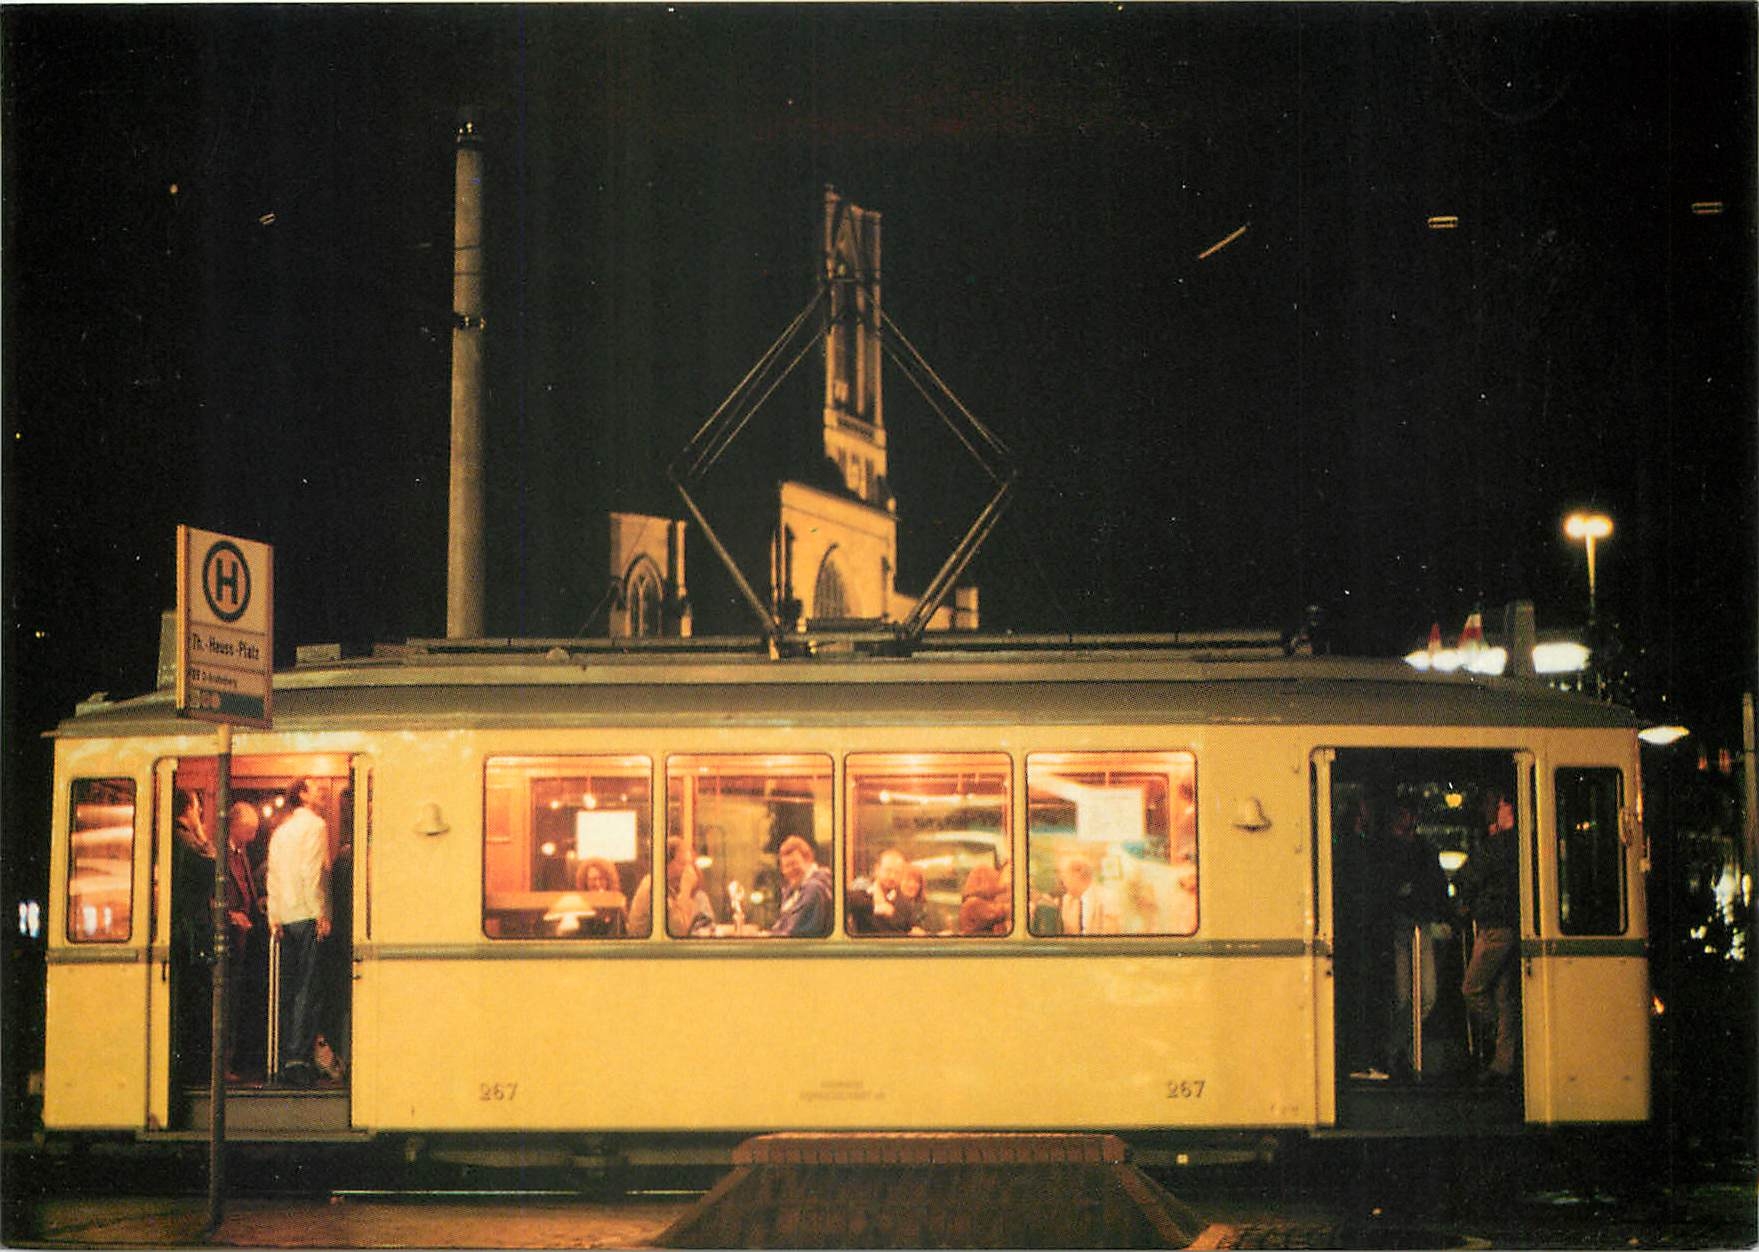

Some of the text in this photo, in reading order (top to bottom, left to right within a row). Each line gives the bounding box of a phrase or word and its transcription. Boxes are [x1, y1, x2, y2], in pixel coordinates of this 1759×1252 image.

[216, 559, 238, 605] H
[480, 1082, 518, 1102] 267
[1167, 1080, 1205, 1099] 267
